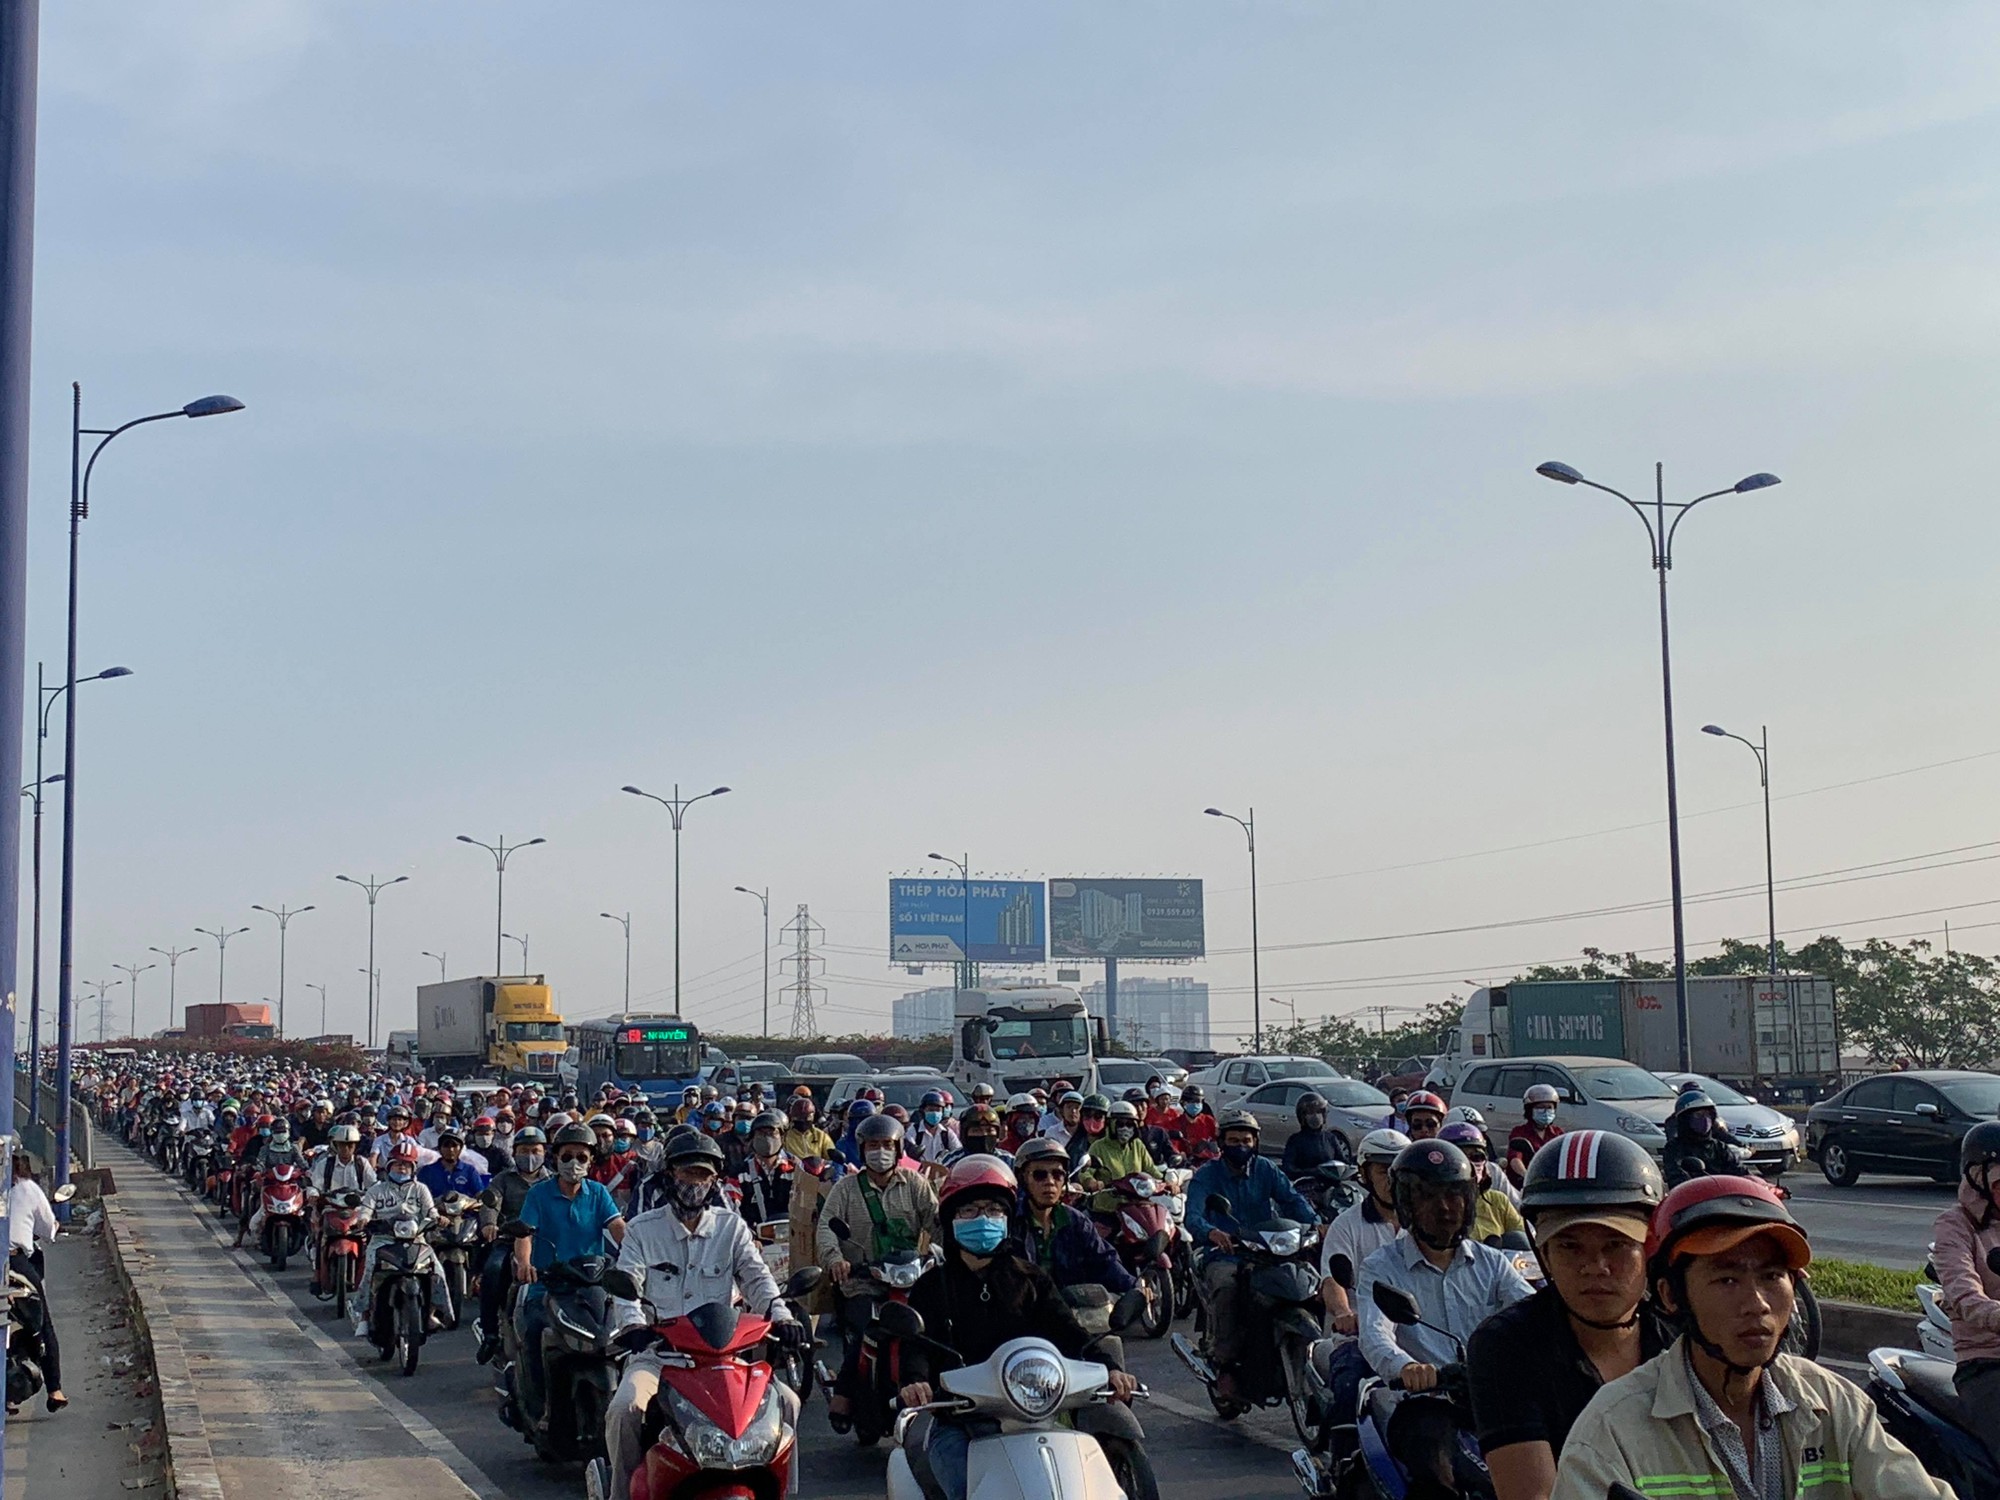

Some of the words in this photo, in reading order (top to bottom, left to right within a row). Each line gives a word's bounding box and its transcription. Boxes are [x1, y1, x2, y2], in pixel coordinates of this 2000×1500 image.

[899, 882, 932, 897] THÉP
[937, 883, 966, 898] HÒA
[972, 884, 1008, 899] PHÁT
[898, 911, 913, 923] SỐ
[914, 914, 919, 922] 1
[920, 912, 941, 925] VIỆT
[941, 914, 965, 923] NAM
